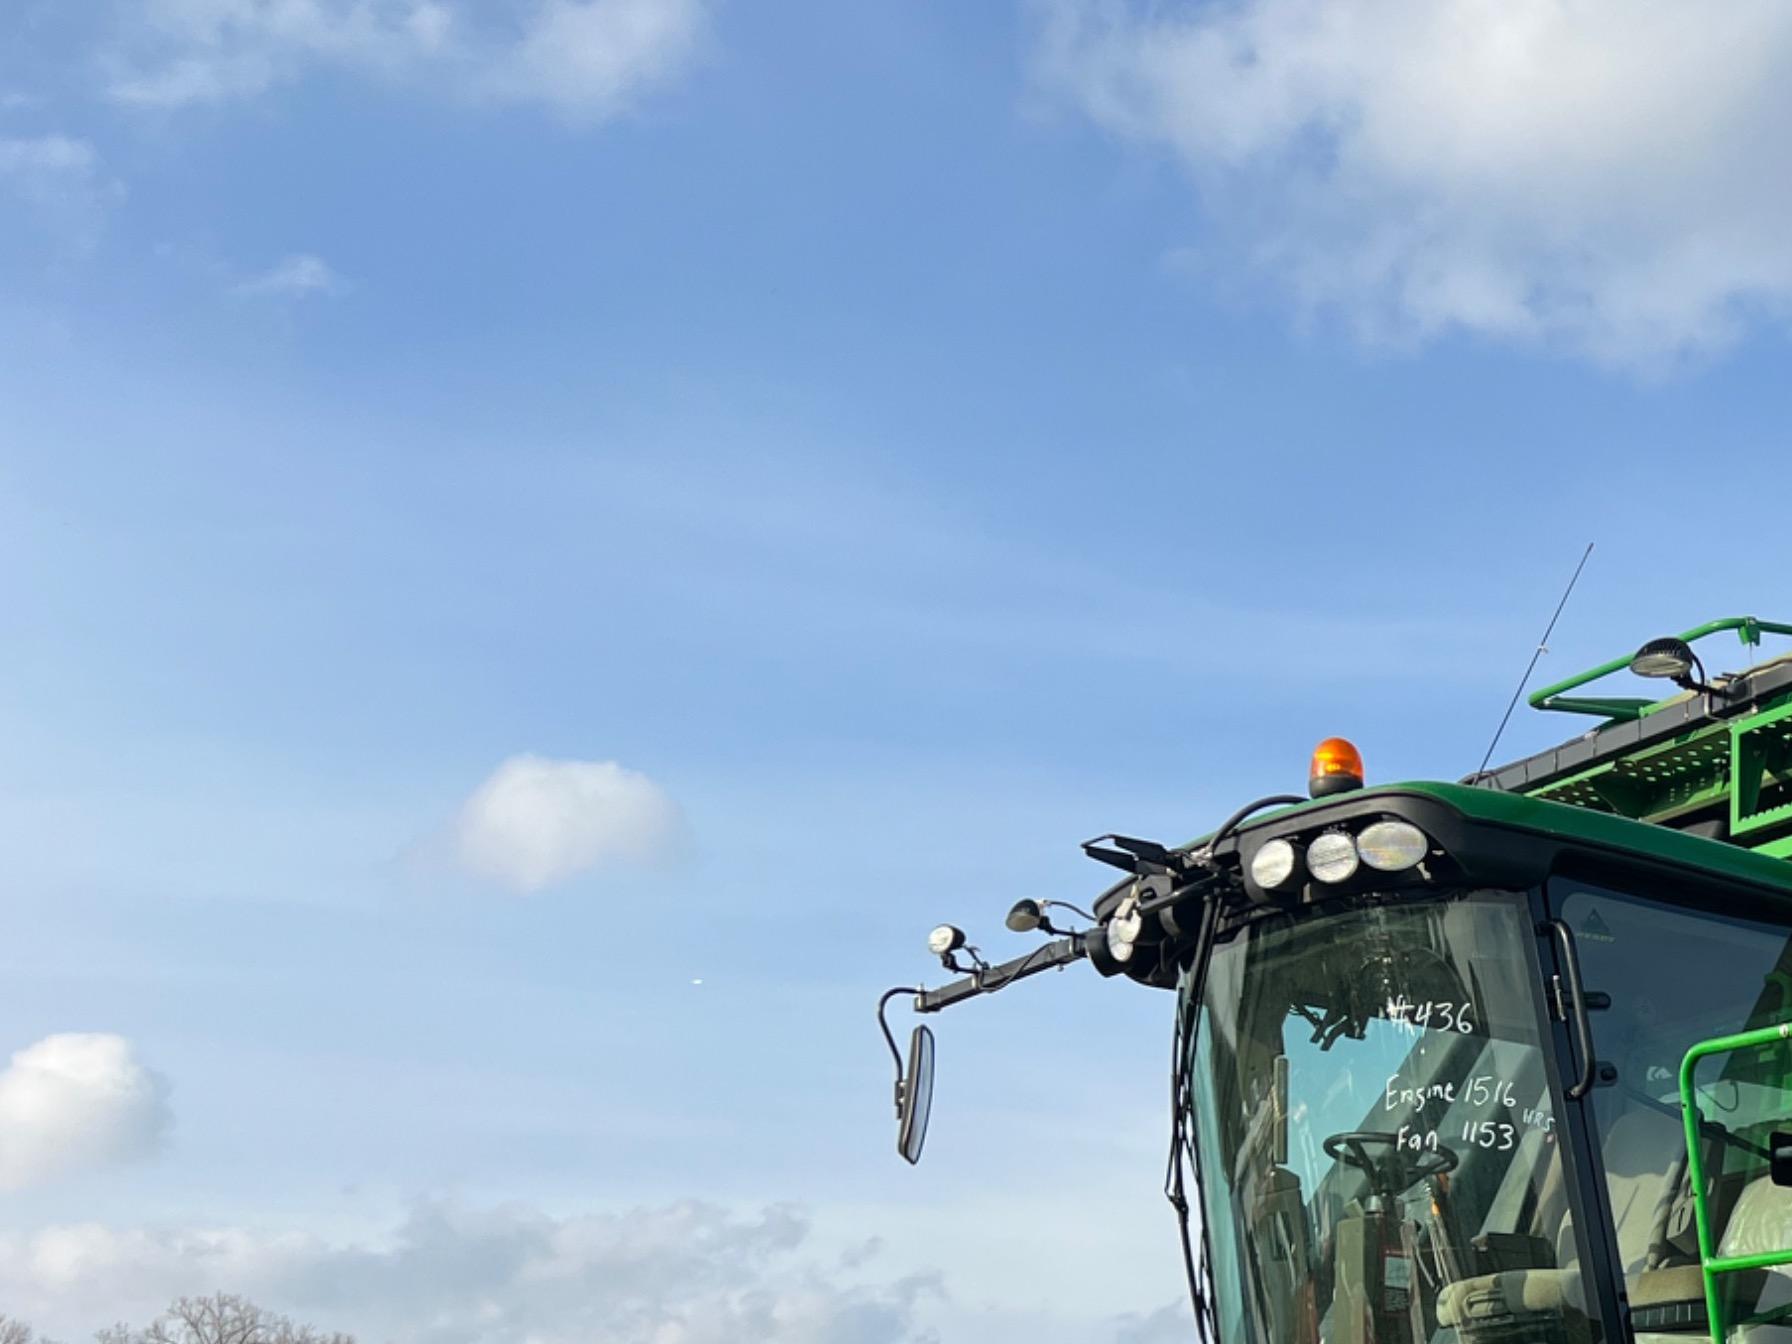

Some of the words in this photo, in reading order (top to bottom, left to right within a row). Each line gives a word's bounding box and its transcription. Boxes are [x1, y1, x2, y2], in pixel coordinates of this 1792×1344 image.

[1385, 1074, 1456, 1113] Engine
[1464, 1076, 1517, 1108] 1516
[1396, 1124, 1438, 1152] Fan
[1462, 1120, 1516, 1150] 1153
